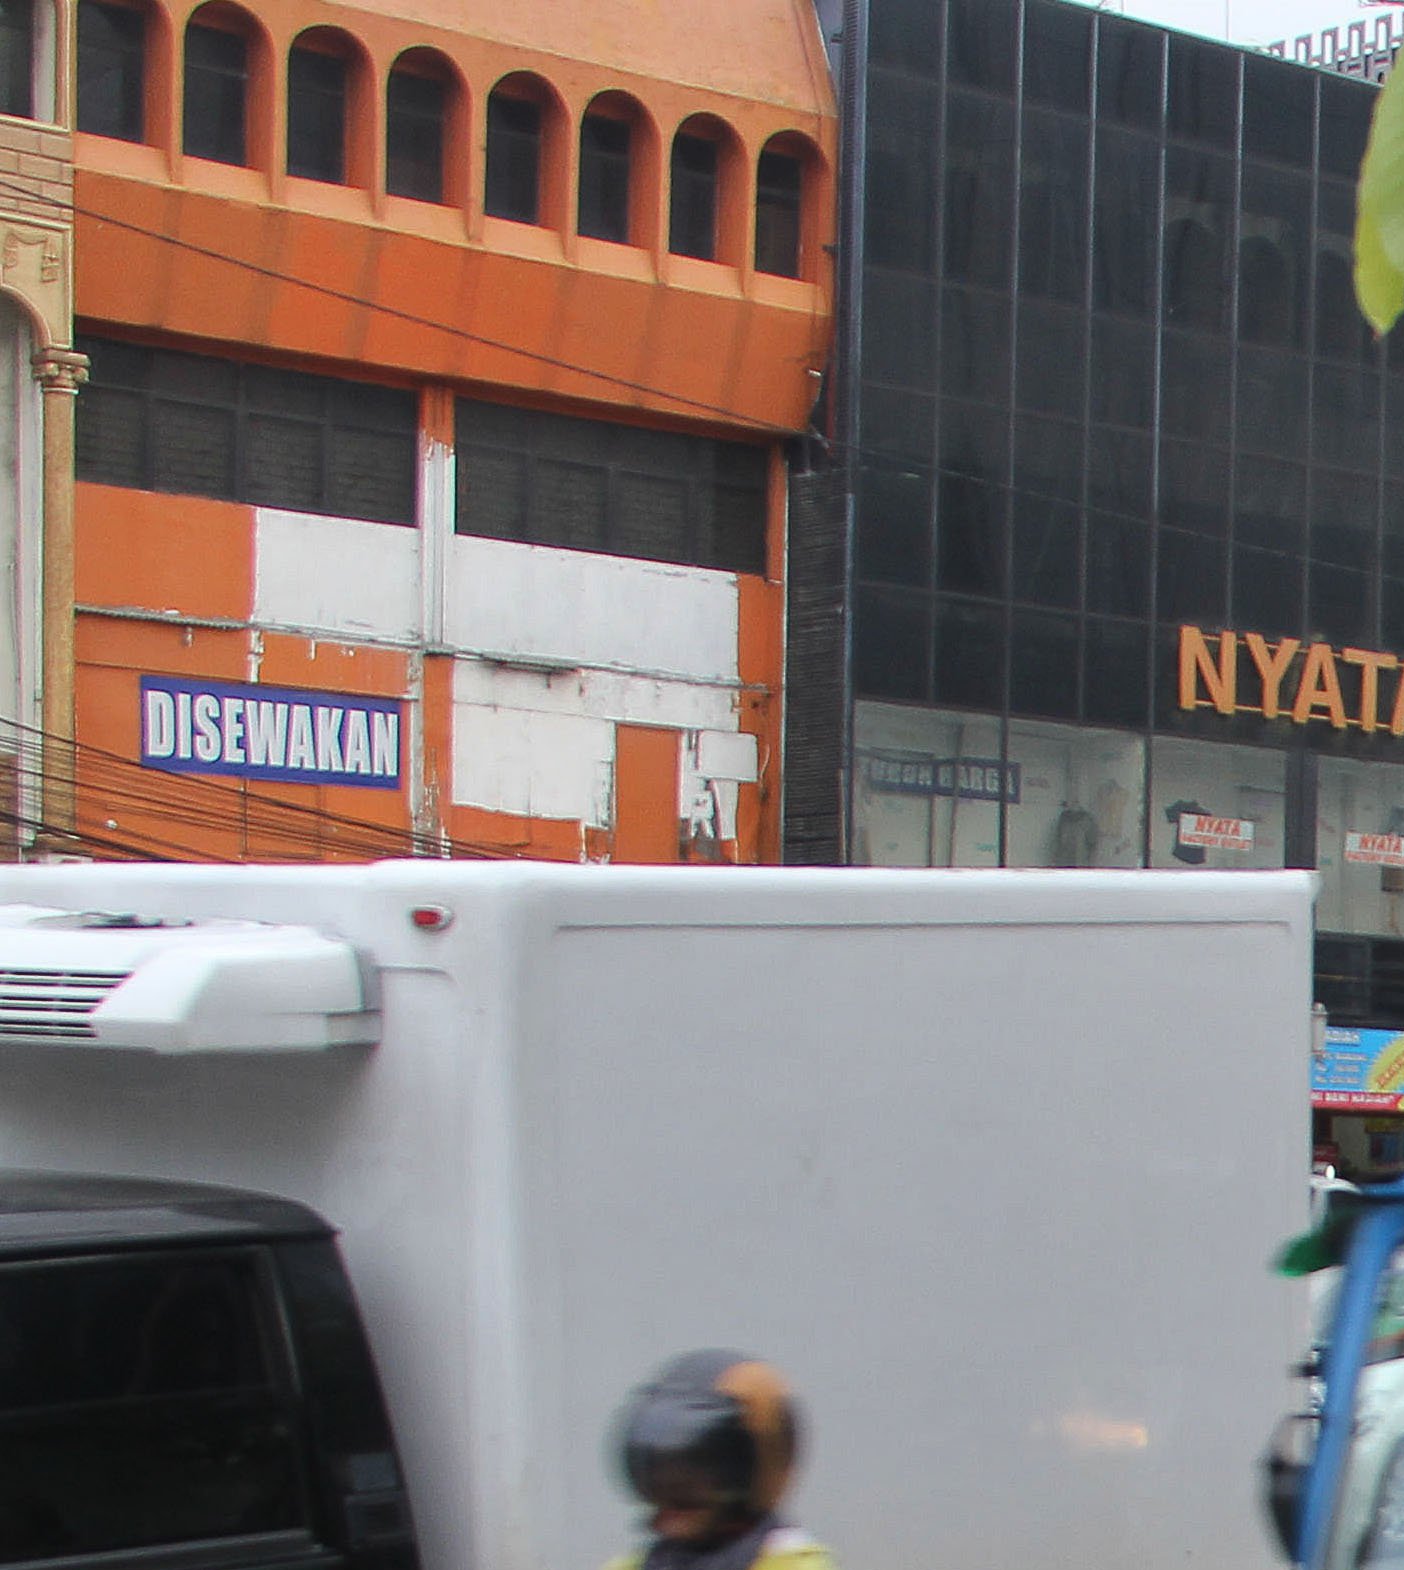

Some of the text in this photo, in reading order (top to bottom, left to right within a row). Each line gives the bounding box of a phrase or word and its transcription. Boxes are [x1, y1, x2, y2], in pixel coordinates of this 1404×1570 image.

[146, 689, 399, 777] DISEWAKAN
[1195, 817, 1242, 837] NYATA
[1359, 833, 1404, 853] NYATA
